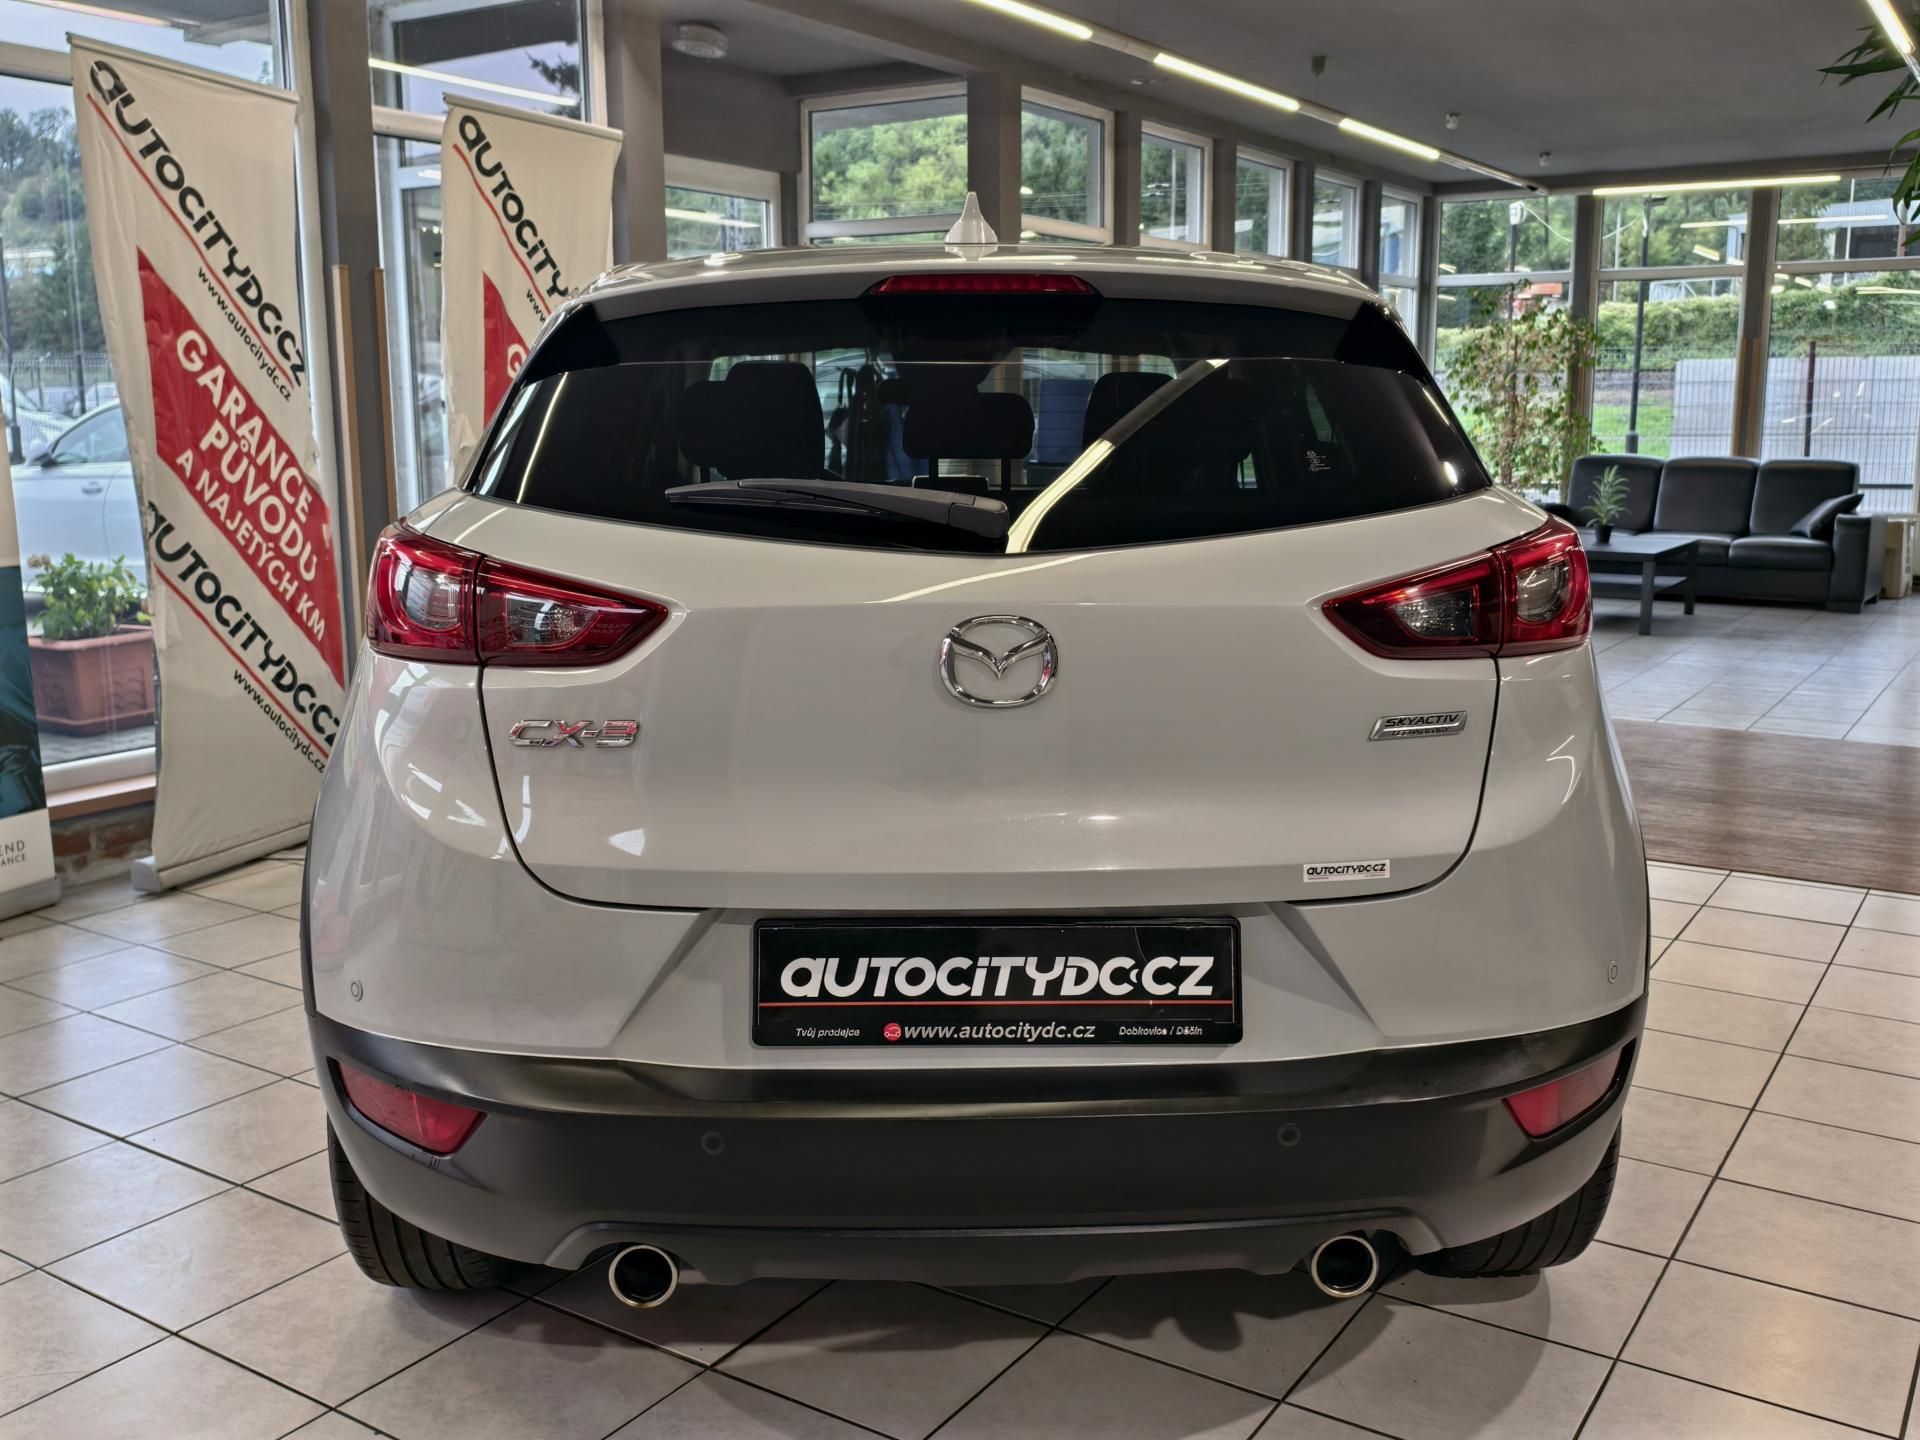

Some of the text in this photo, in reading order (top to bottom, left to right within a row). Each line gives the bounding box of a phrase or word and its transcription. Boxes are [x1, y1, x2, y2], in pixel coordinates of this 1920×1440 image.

[198, 268, 291, 402] www.autocitydc.cz
[176, 329, 313, 523] GARANCE
[199, 419, 318, 582] PŮVODU
[175, 449, 326, 642] A NAJETÝCH KM
[233, 669, 326, 773] www.autocitydc.cz
[508, 719, 640, 748] CX-3
[1384, 714, 1459, 728] SKYACTIV
[1391, 726, 1449, 737] TECHNOLOGY
[796, 1027, 860, 1038] Tvůj prodejce
[904, 1022, 1096, 1042] www.autocitydc.cz
[1119, 1026, 1167, 1036] Dobkovice
[1176, 1026, 1203, 1036] Děčín
